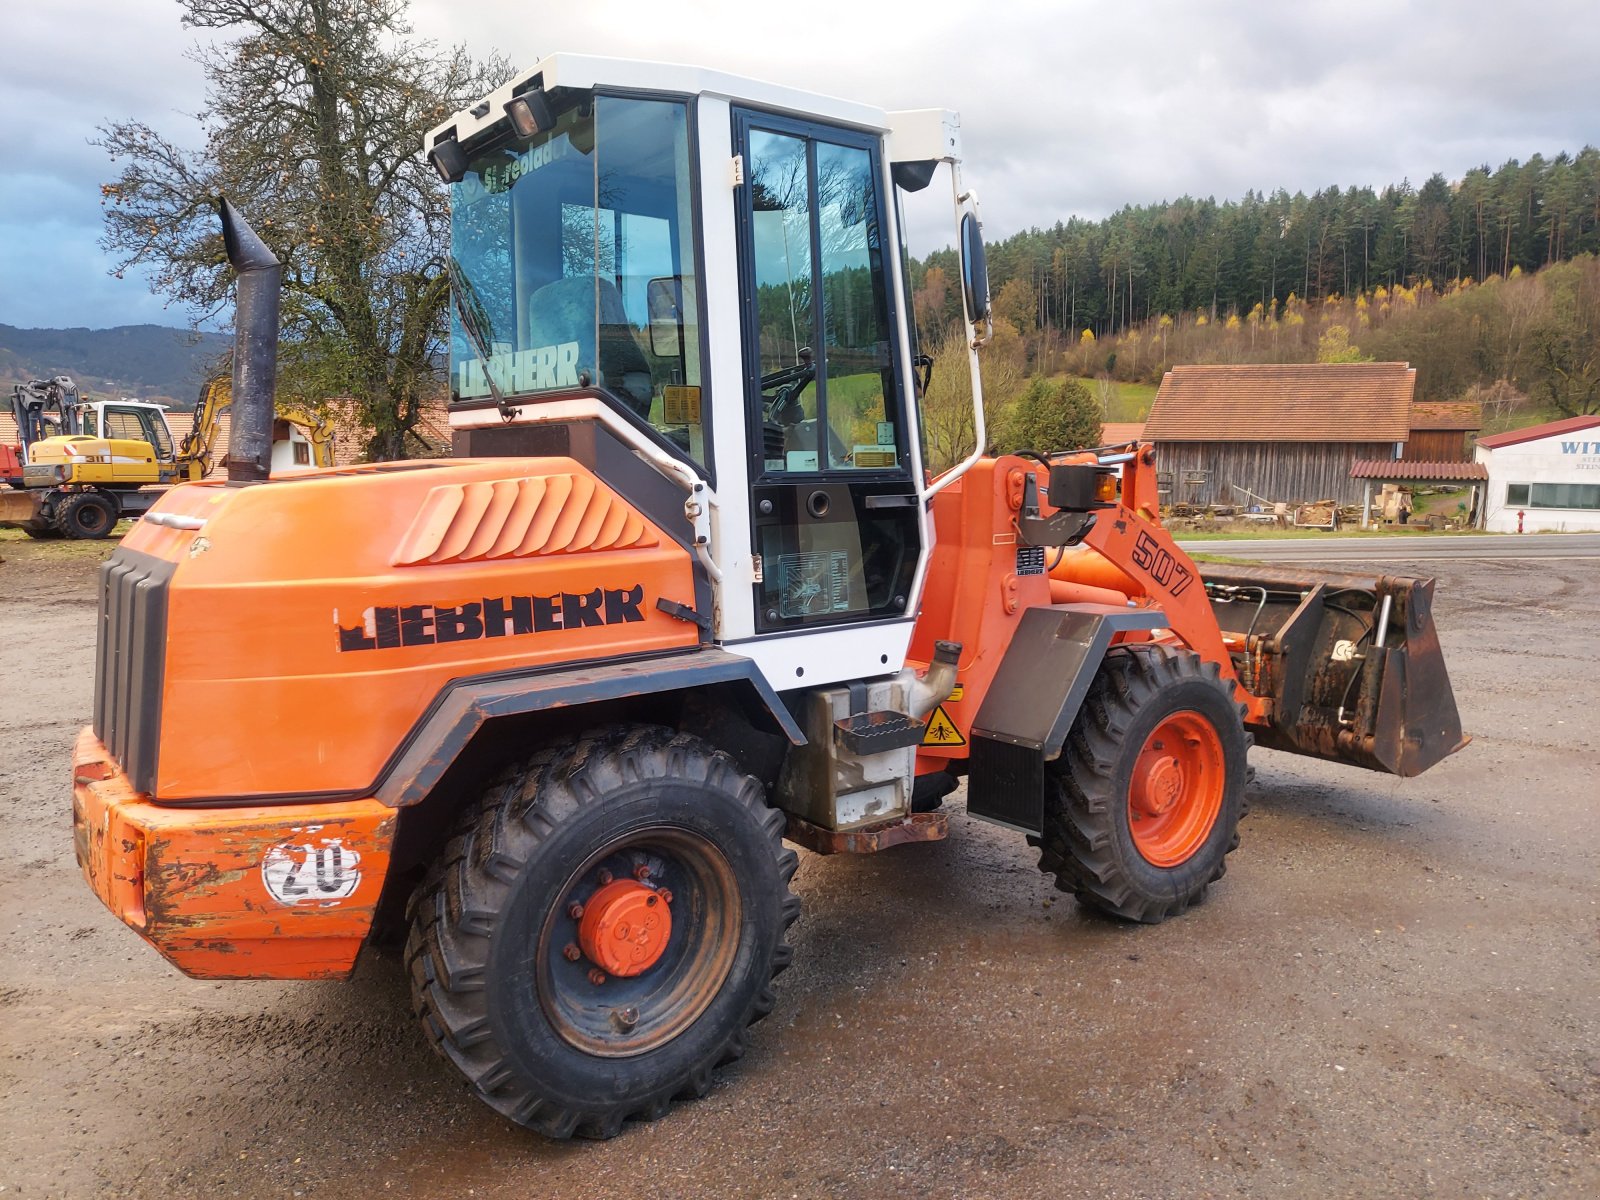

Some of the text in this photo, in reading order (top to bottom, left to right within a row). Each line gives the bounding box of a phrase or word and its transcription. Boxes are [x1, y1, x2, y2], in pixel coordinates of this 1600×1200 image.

[460, 341, 579, 398] LIEBHERR
[1132, 529, 1194, 597] 507
[334, 583, 646, 652] LIEBHERR
